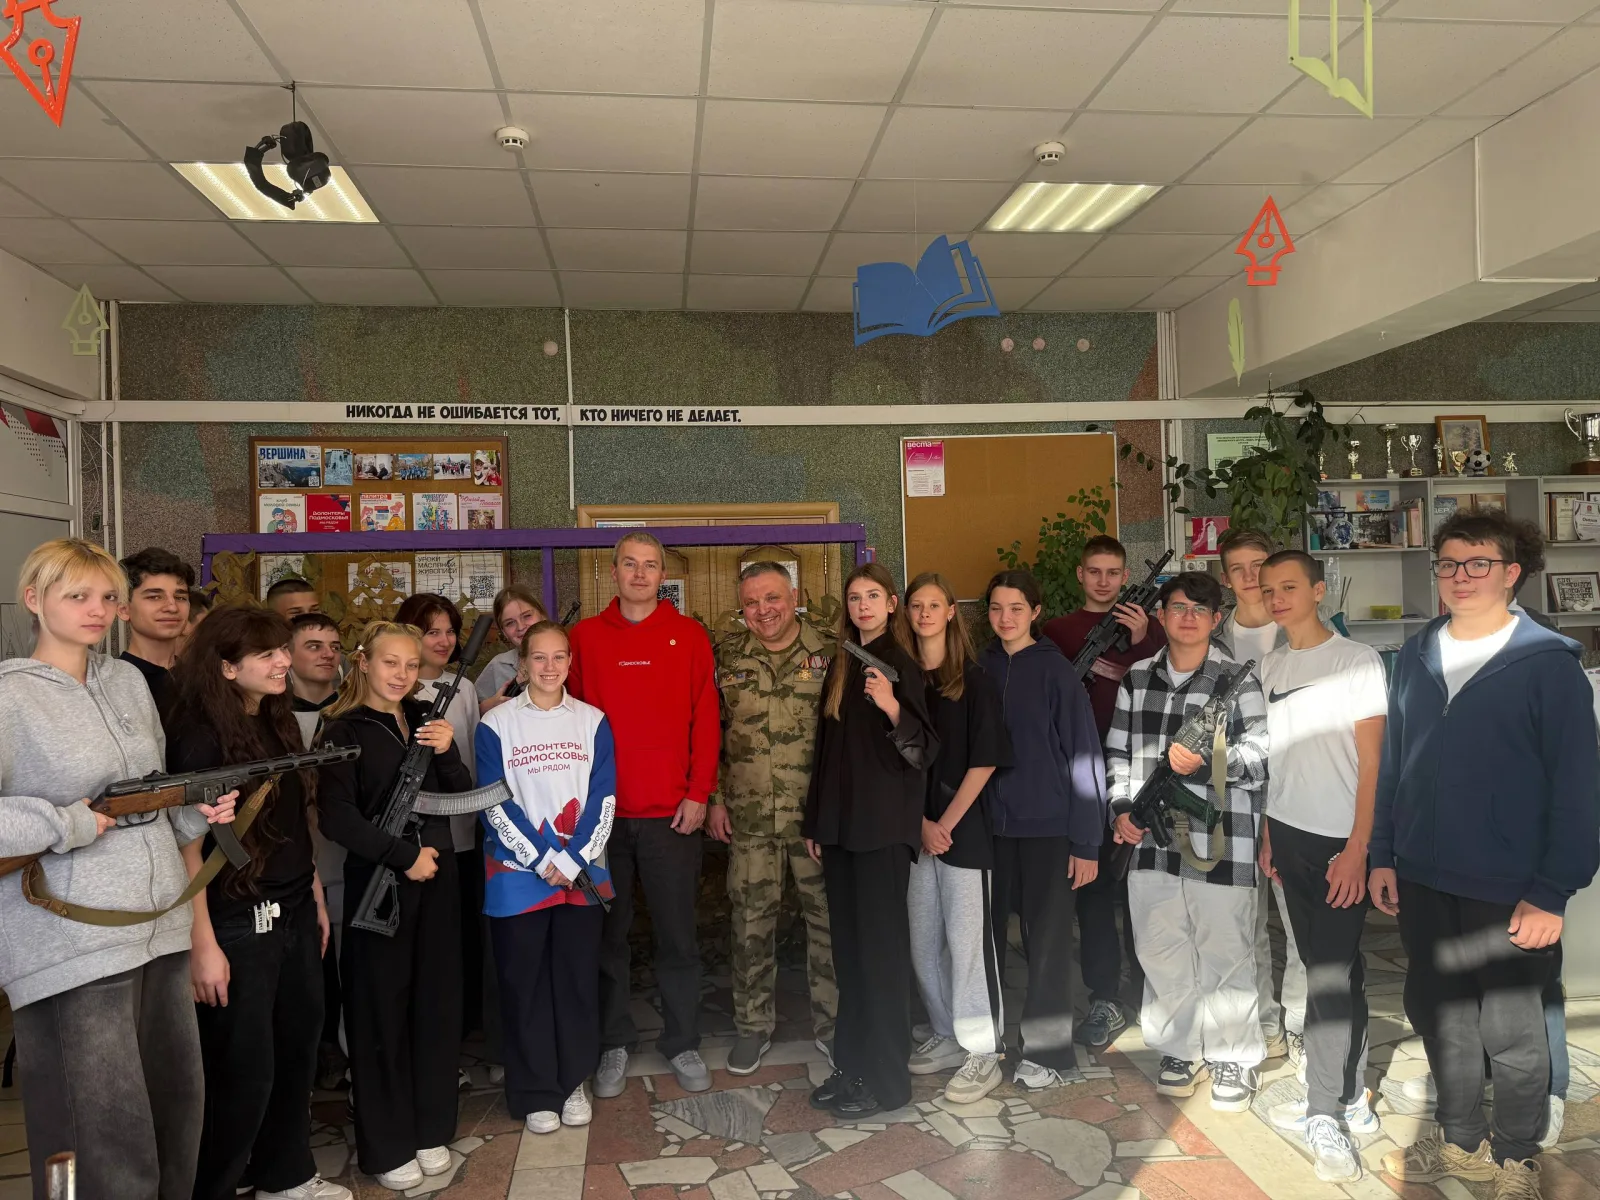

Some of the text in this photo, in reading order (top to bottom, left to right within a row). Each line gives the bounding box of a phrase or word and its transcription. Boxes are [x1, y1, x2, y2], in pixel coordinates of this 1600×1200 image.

[346, 404, 742, 423] НИКОГДА НЕ ОШИБАЕТСЯ ТОТ, КТО НИЧЕГО НЕ ДЕЛАЕТ.
[260, 447, 306, 460] ВЕРШИНА
[512, 741, 583, 757] ВОЛОНТЕРЫ
[508, 751, 589, 770] ПОДМОСКОВЬЯ
[527, 763, 571, 775] МЫ РЯДОМ
[512, 840, 531, 858] МЫ
